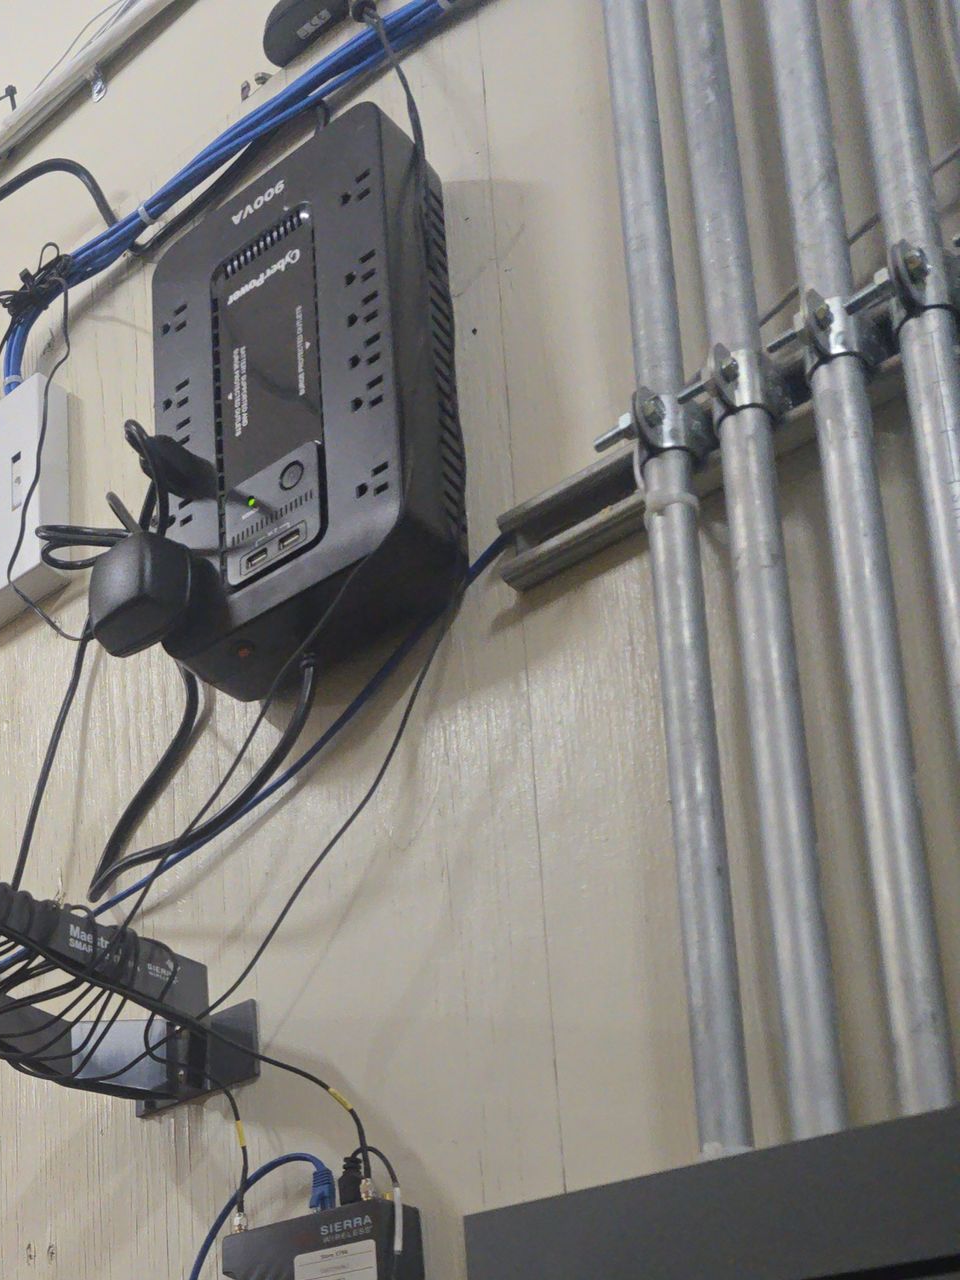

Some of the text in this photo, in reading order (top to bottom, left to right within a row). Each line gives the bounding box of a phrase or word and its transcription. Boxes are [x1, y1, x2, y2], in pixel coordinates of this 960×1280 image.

[231, 179, 286, 226] 900VA
[227, 248, 301, 306] CyberPower
[319, 1214, 372, 1236] SIERRA
